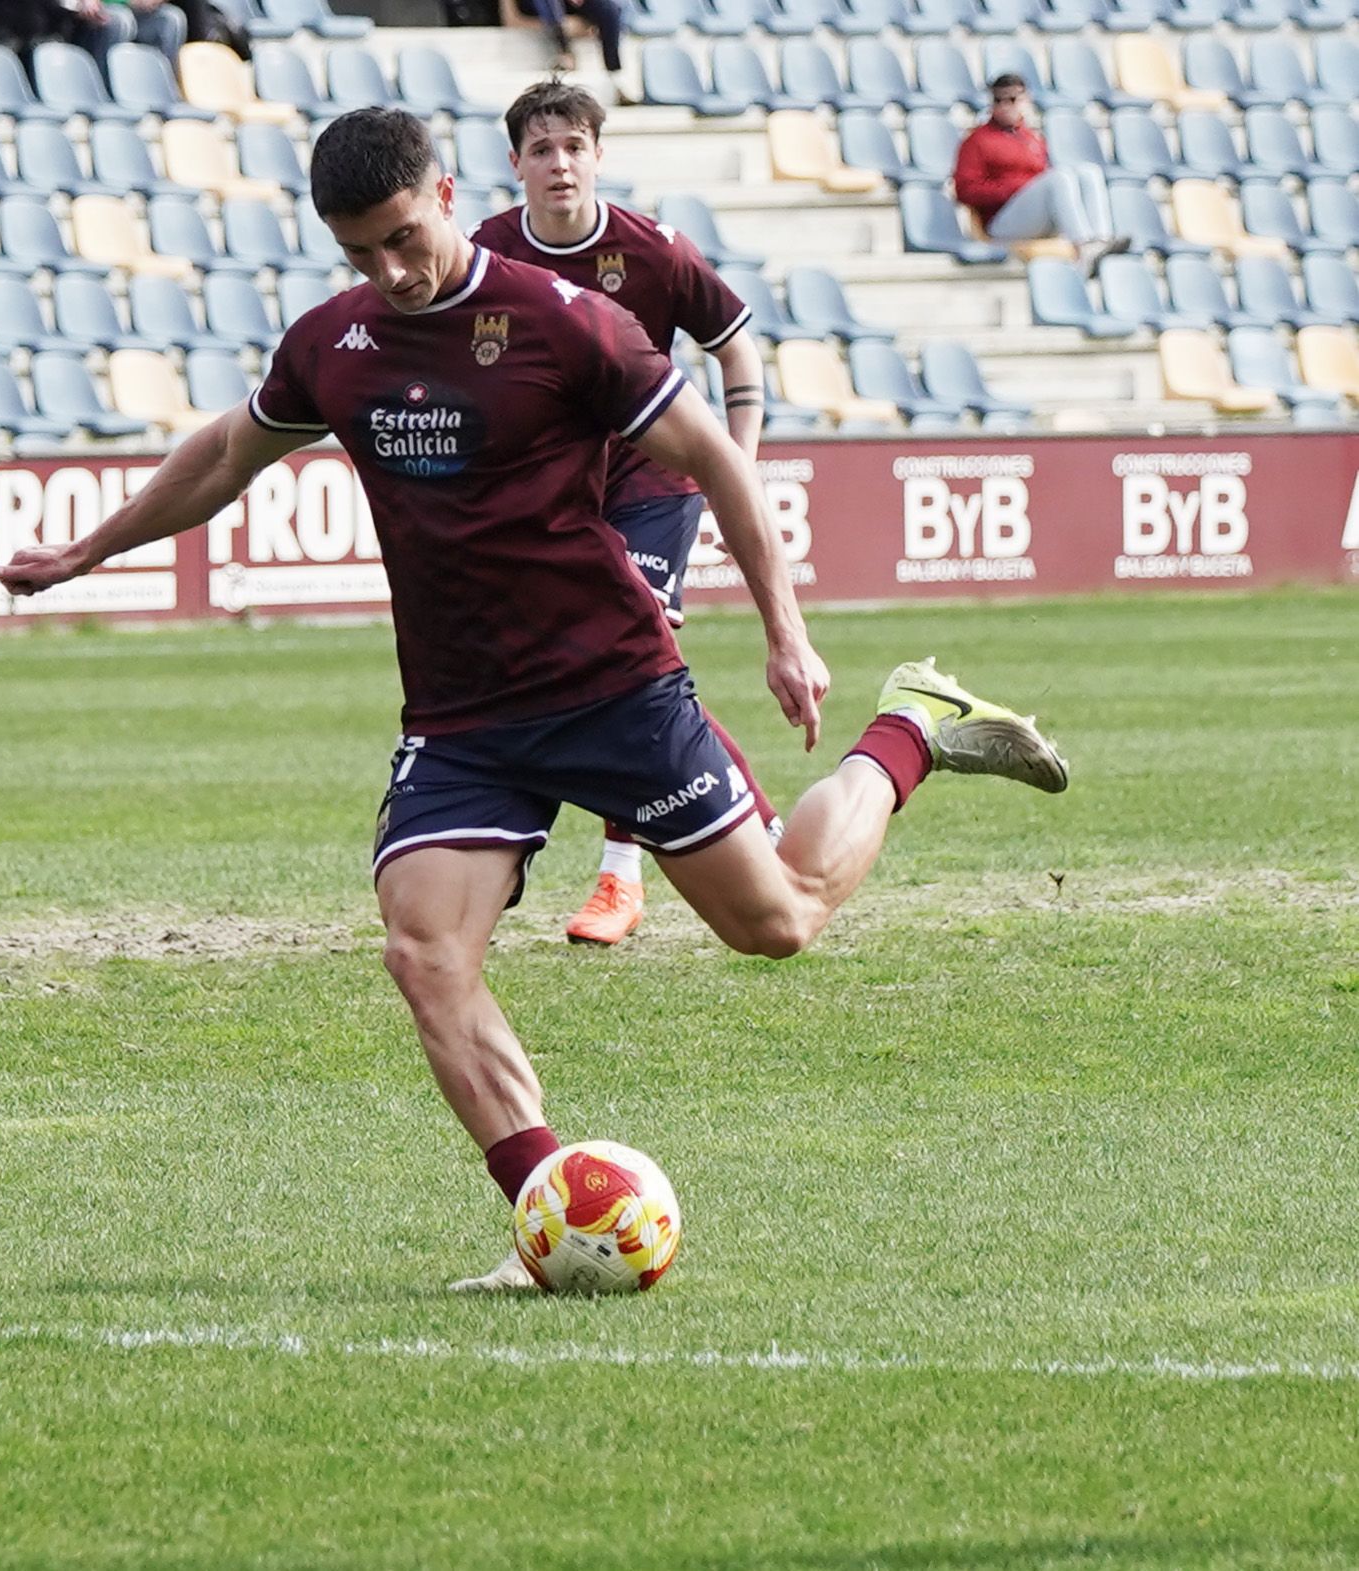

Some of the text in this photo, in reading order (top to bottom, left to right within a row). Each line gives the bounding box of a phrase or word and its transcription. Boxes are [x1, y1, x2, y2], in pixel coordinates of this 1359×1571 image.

[370, 407, 462, 431] Estrella
[374, 430, 458, 457] Galicia
[904, 477, 1032, 559] ByB
[1122, 473, 1249, 555] ByB
[630, 551, 669, 573] ANCA
